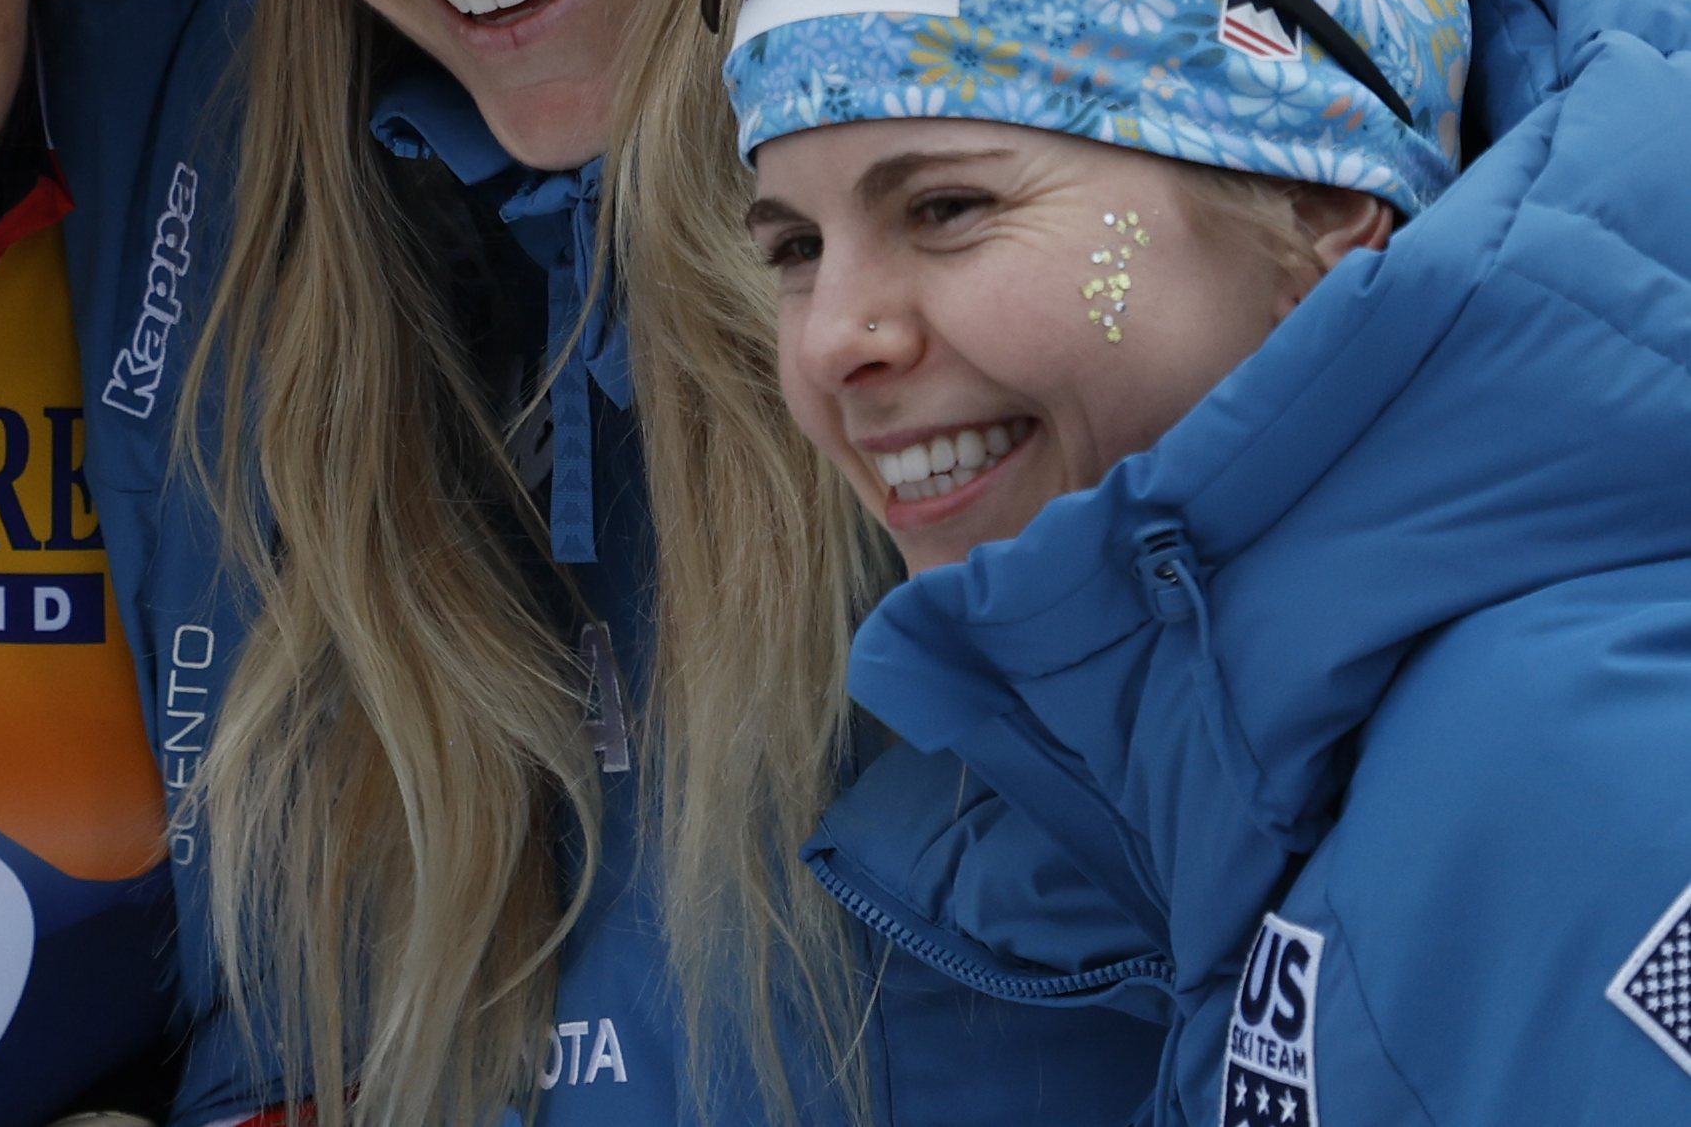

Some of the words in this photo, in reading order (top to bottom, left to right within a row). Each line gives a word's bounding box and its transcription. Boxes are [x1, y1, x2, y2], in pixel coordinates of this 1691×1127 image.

[101, 161, 199, 420] Kappa
[1240, 925, 1310, 1043] US
[1231, 1024, 1254, 1061] SKI
[1257, 1035, 1308, 1079] TEAM
